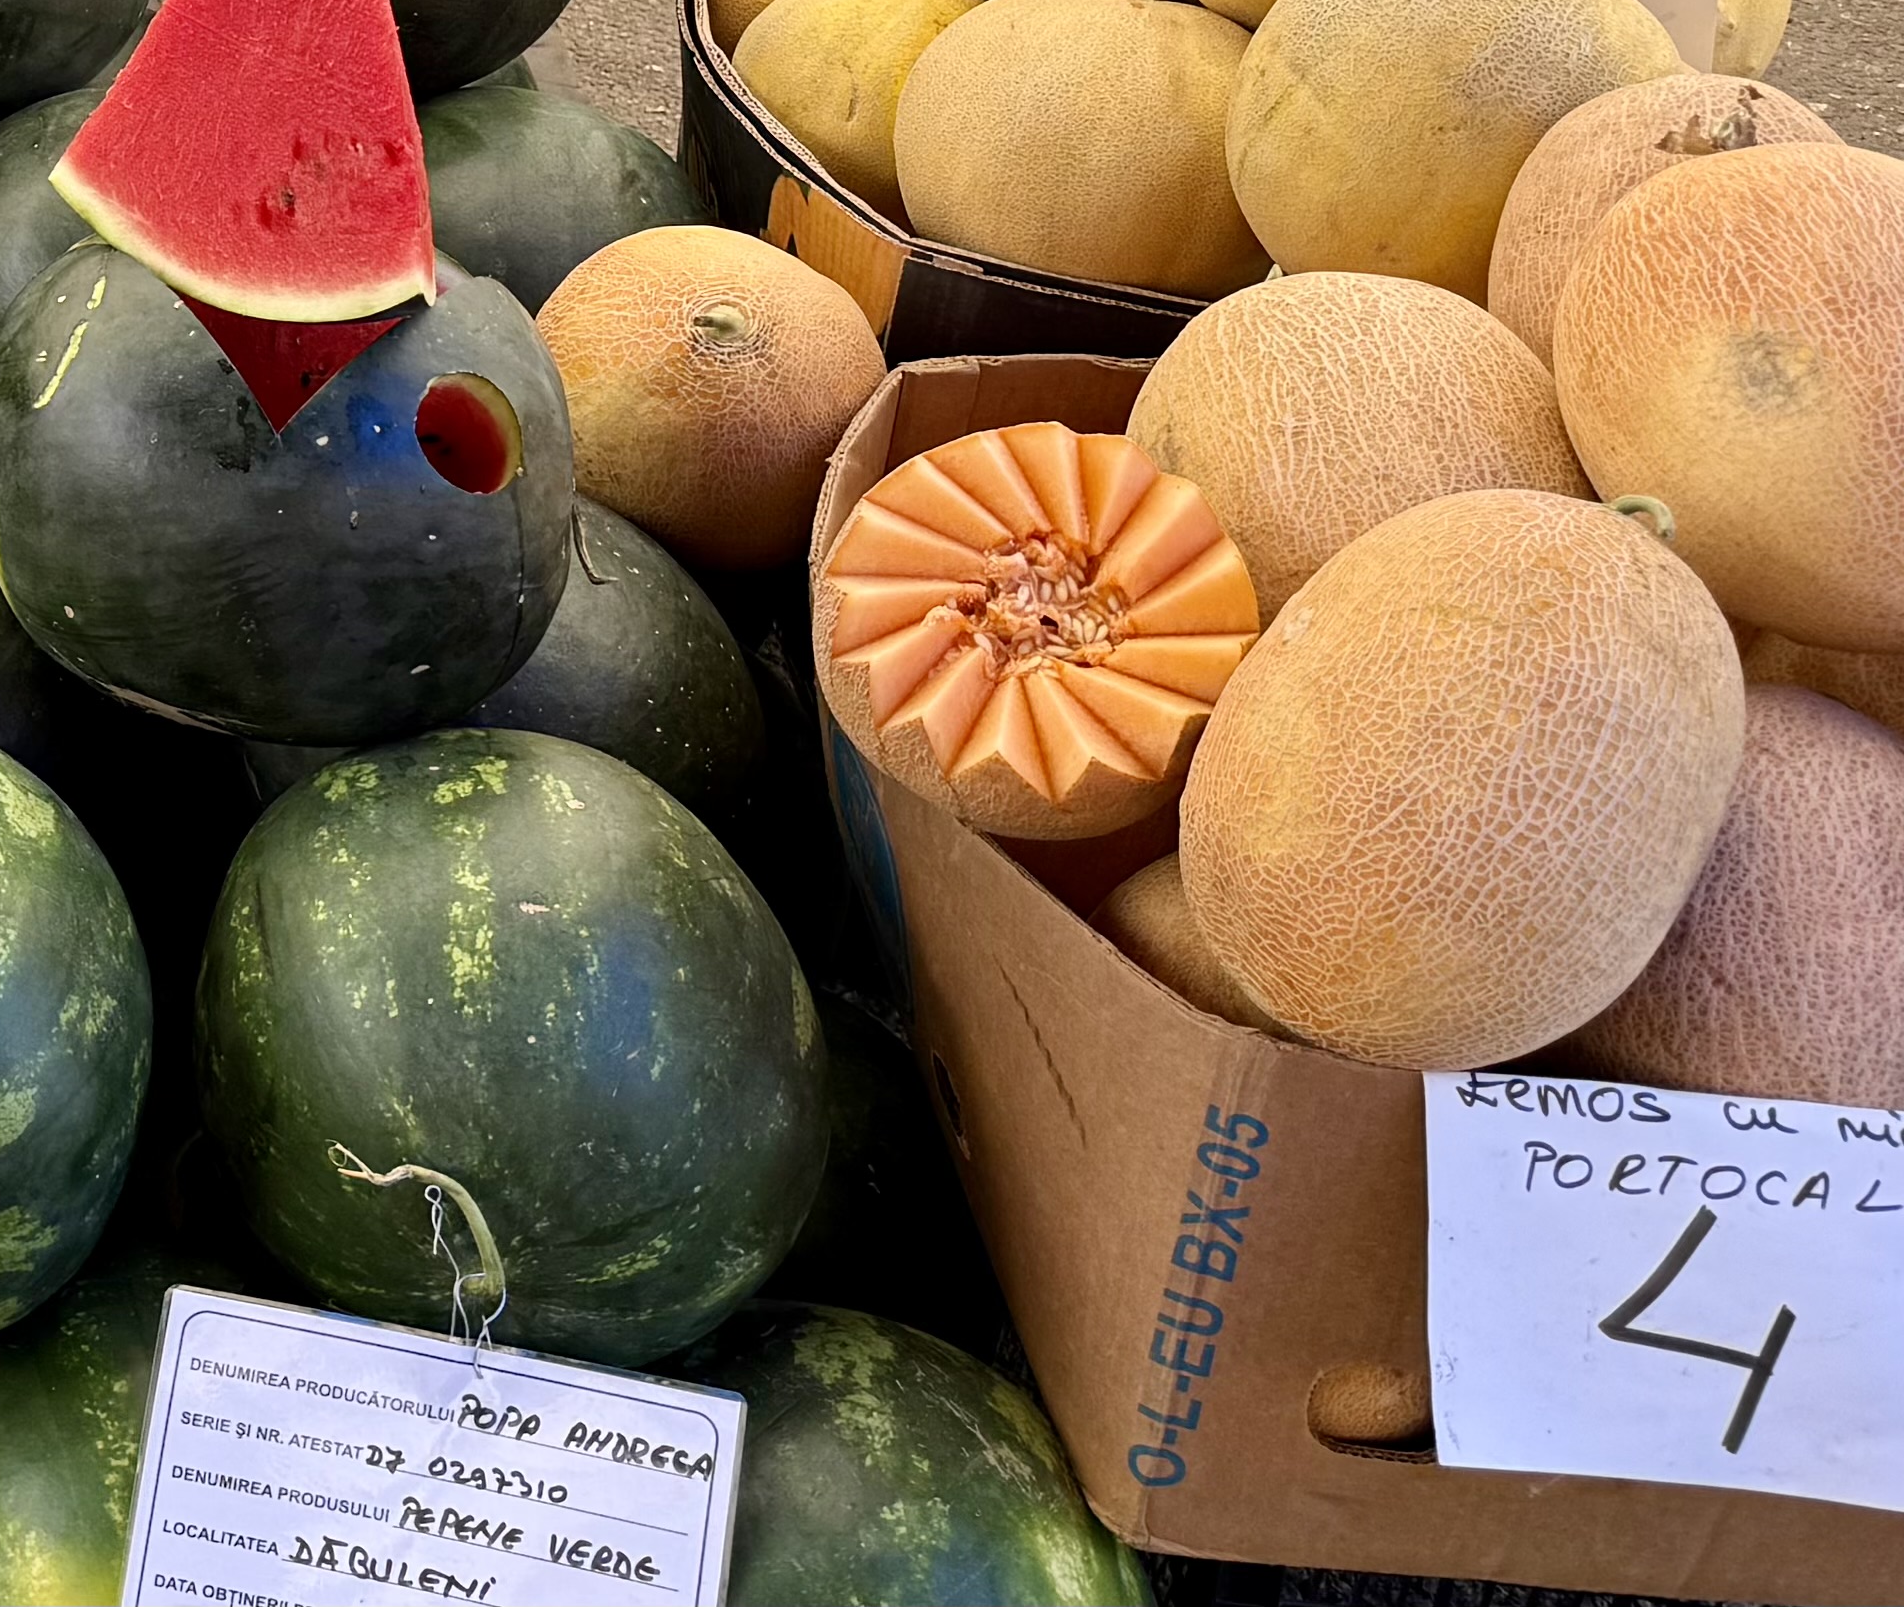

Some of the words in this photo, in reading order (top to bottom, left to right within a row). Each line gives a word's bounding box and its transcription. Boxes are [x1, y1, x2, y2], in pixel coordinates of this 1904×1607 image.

[1838, 1110, 1904, 1149] mi
[1597, 1205, 1796, 1454] 4
[190, 1357, 291, 1390] DENUMIREA
[295, 1378, 455, 1423] PRODUCĂTORULUI
[457, 1393, 541, 1441] POPA
[180, 1411, 231, 1433] SERIE
[257, 1426, 284, 1445] NR.
[288, 1433, 364, 1460] ATESTAT
[428, 1457, 568, 1503] 0297310
[162, 1519, 280, 1557] LOCALITATEA
[171, 1464, 274, 1499] DENUMIREA
[277, 1487, 390, 1523] PRODUSULUI
[398, 1496, 524, 1550] PEPENE
[549, 1532, 661, 1581] VERDE
[153, 1573, 197, 1596] DATA
